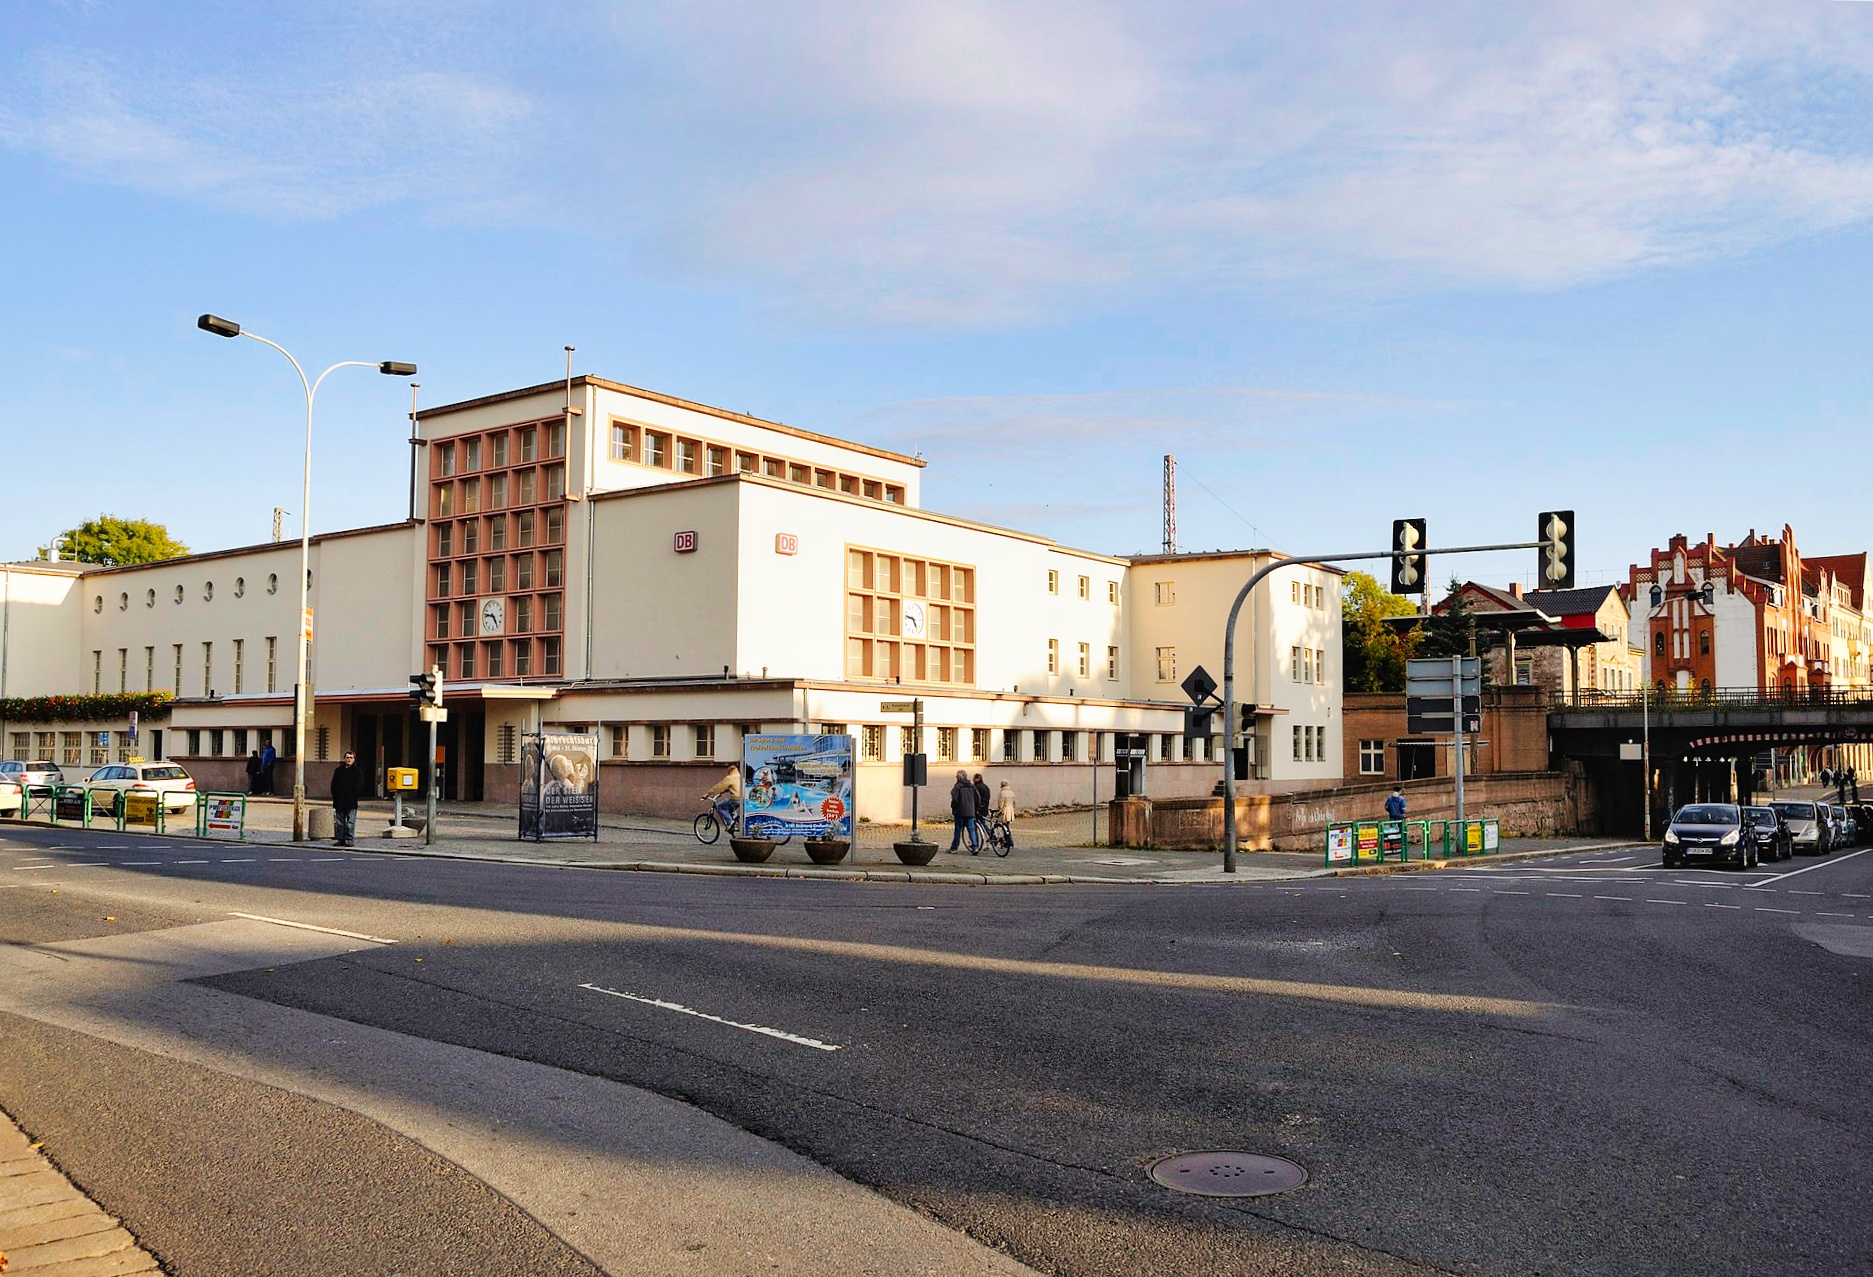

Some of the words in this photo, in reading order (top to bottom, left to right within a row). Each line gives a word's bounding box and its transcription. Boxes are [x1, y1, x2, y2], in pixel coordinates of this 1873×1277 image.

[677, 534, 692, 549] DB
[781, 536, 795, 551] DB
[546, 786, 560, 795] DER
[545, 796, 560, 804] DER
[563, 795, 593, 804] WEISSEN
